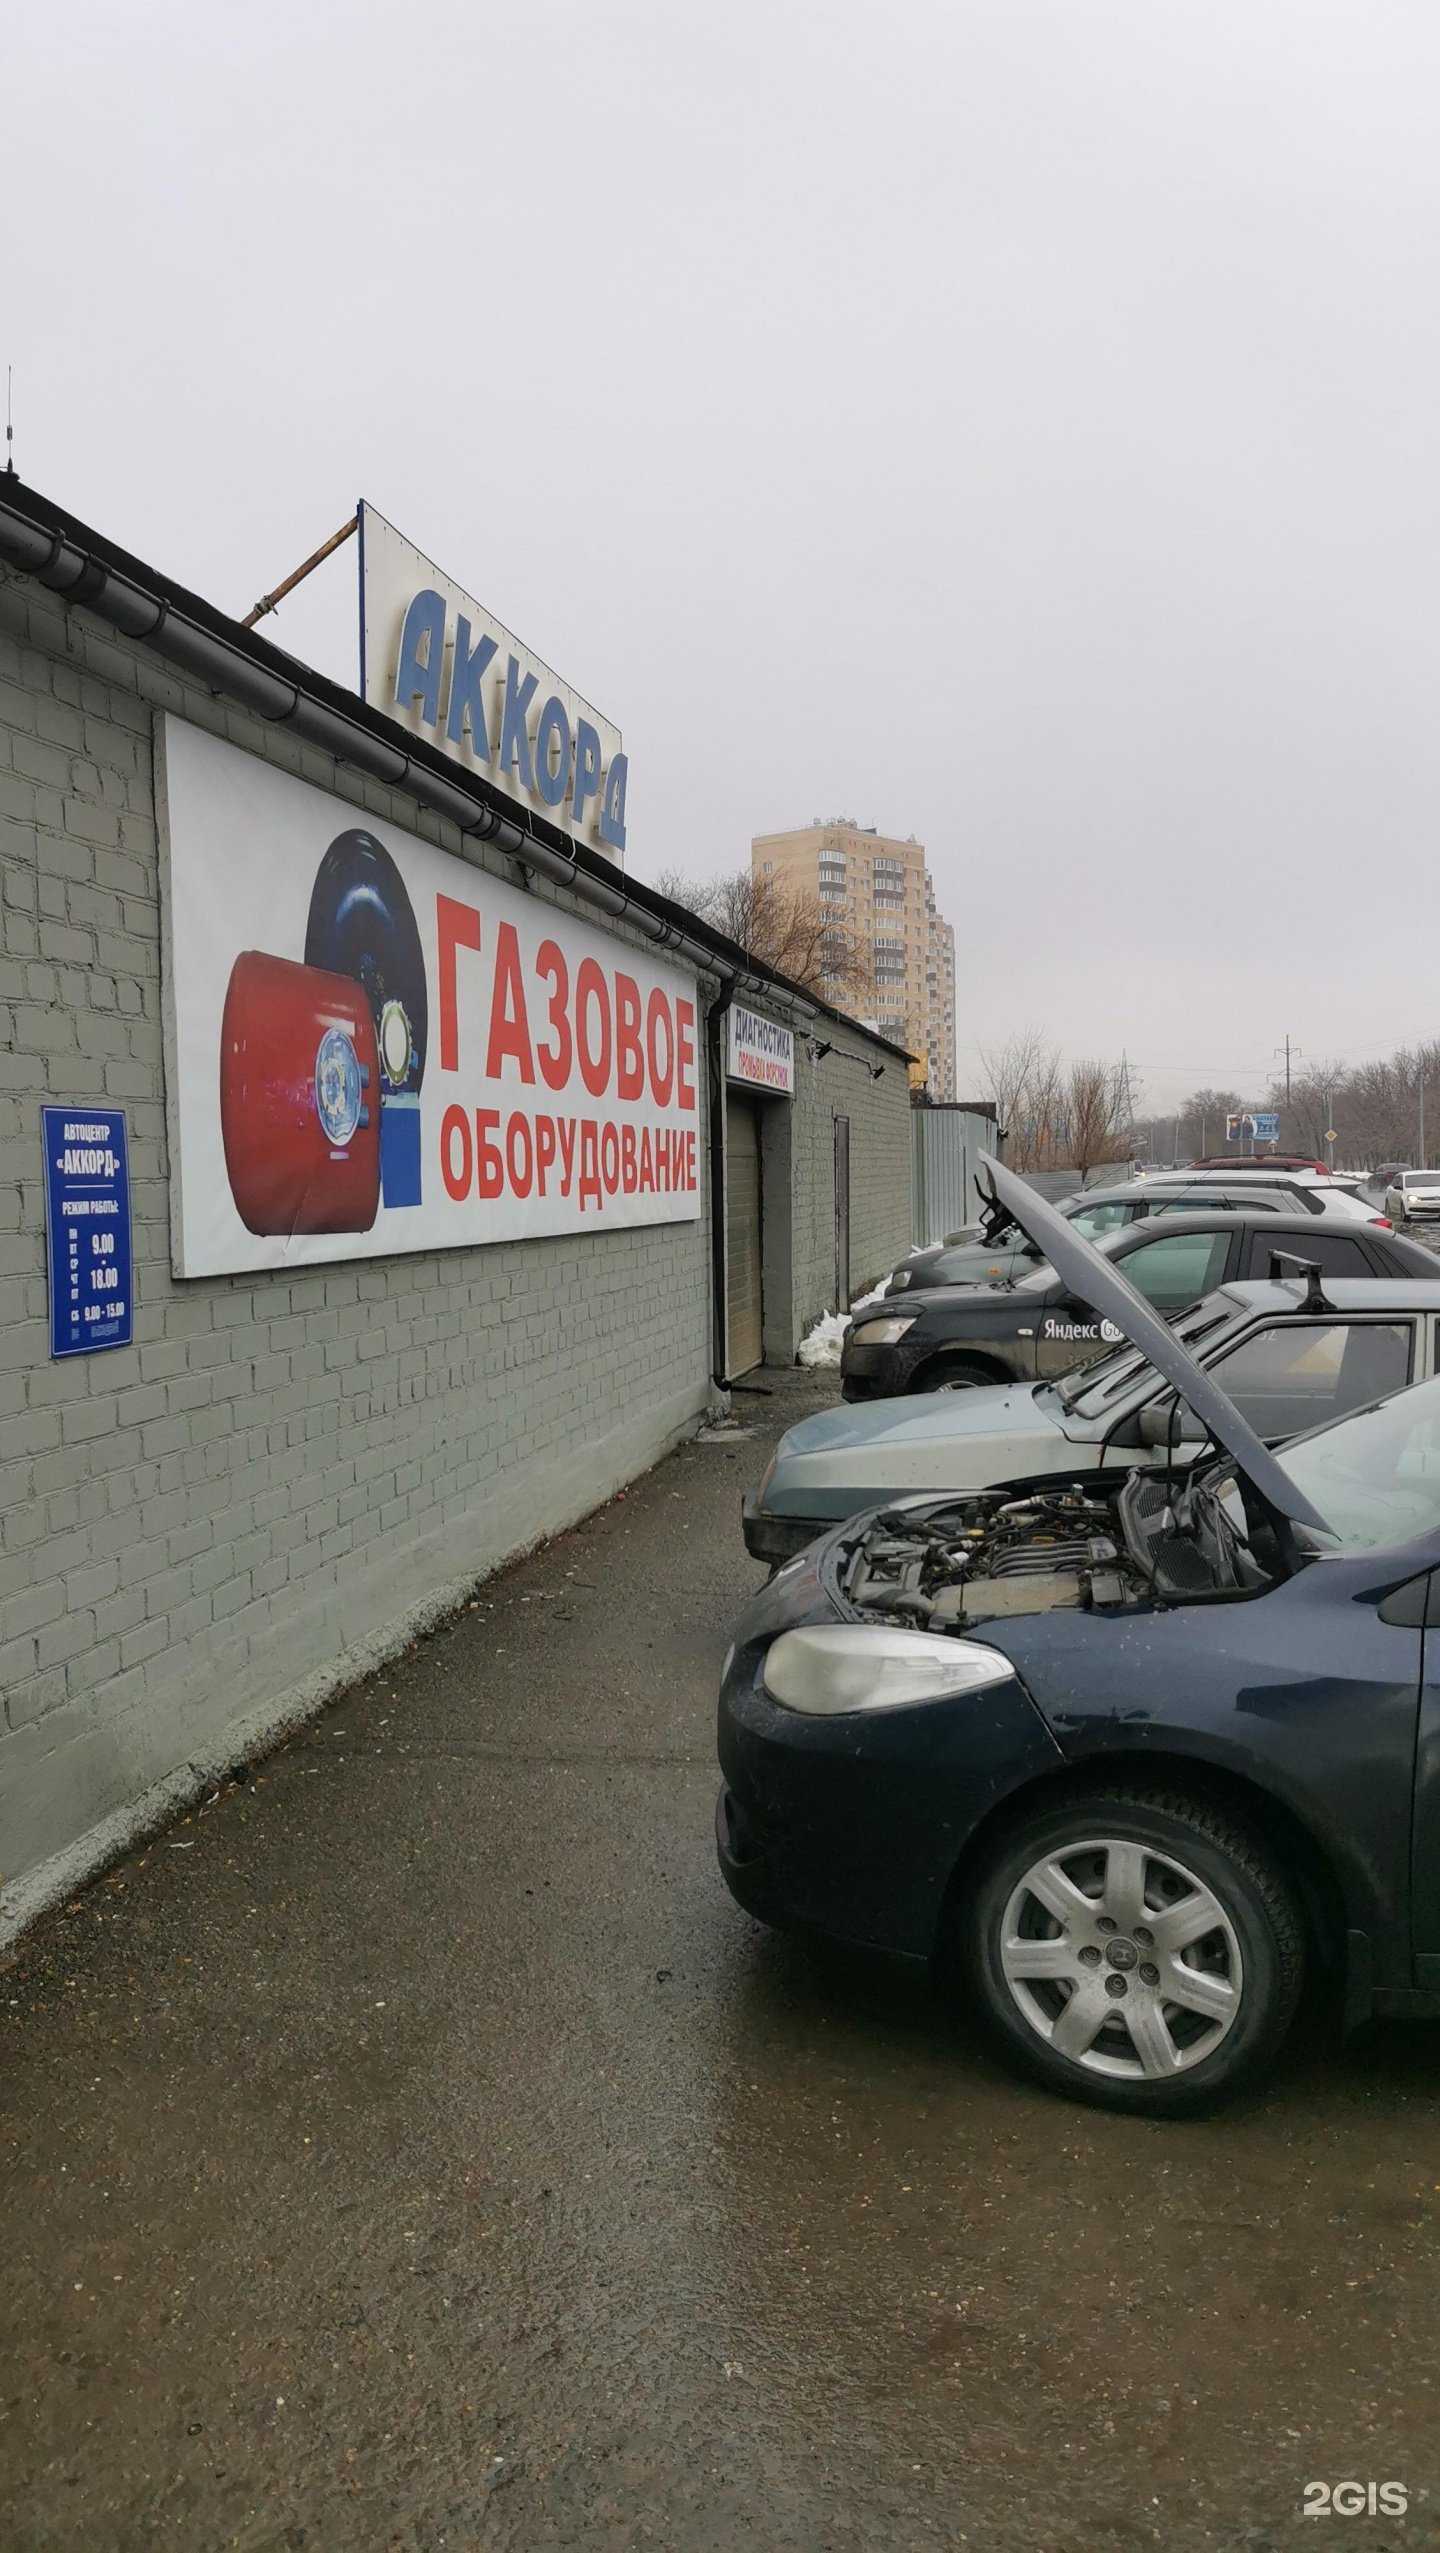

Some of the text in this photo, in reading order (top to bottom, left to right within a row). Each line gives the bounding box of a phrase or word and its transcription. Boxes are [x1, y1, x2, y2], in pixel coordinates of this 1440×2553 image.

[395, 589, 628, 850] АККОРД
[436, 892, 695, 1111] ГАЗОВОЕ
[735, 1008, 790, 1060] ДИАГНОСТИКА
[64, 1123, 110, 1142] АВТОЦЕНТР
[56, 1149, 120, 1176] «АККОРД»
[440, 1104, 697, 1211] ОБОРУДОВАНИЕ
[62, 1201, 89, 1216] РЕЖИМ
[92, 1233, 114, 1254] 9.00
[90, 1267, 118, 1290] 18.00
[84, 1305, 101, 1321] 9.00
[1045, 1319, 1098, 1340] Яндекс
